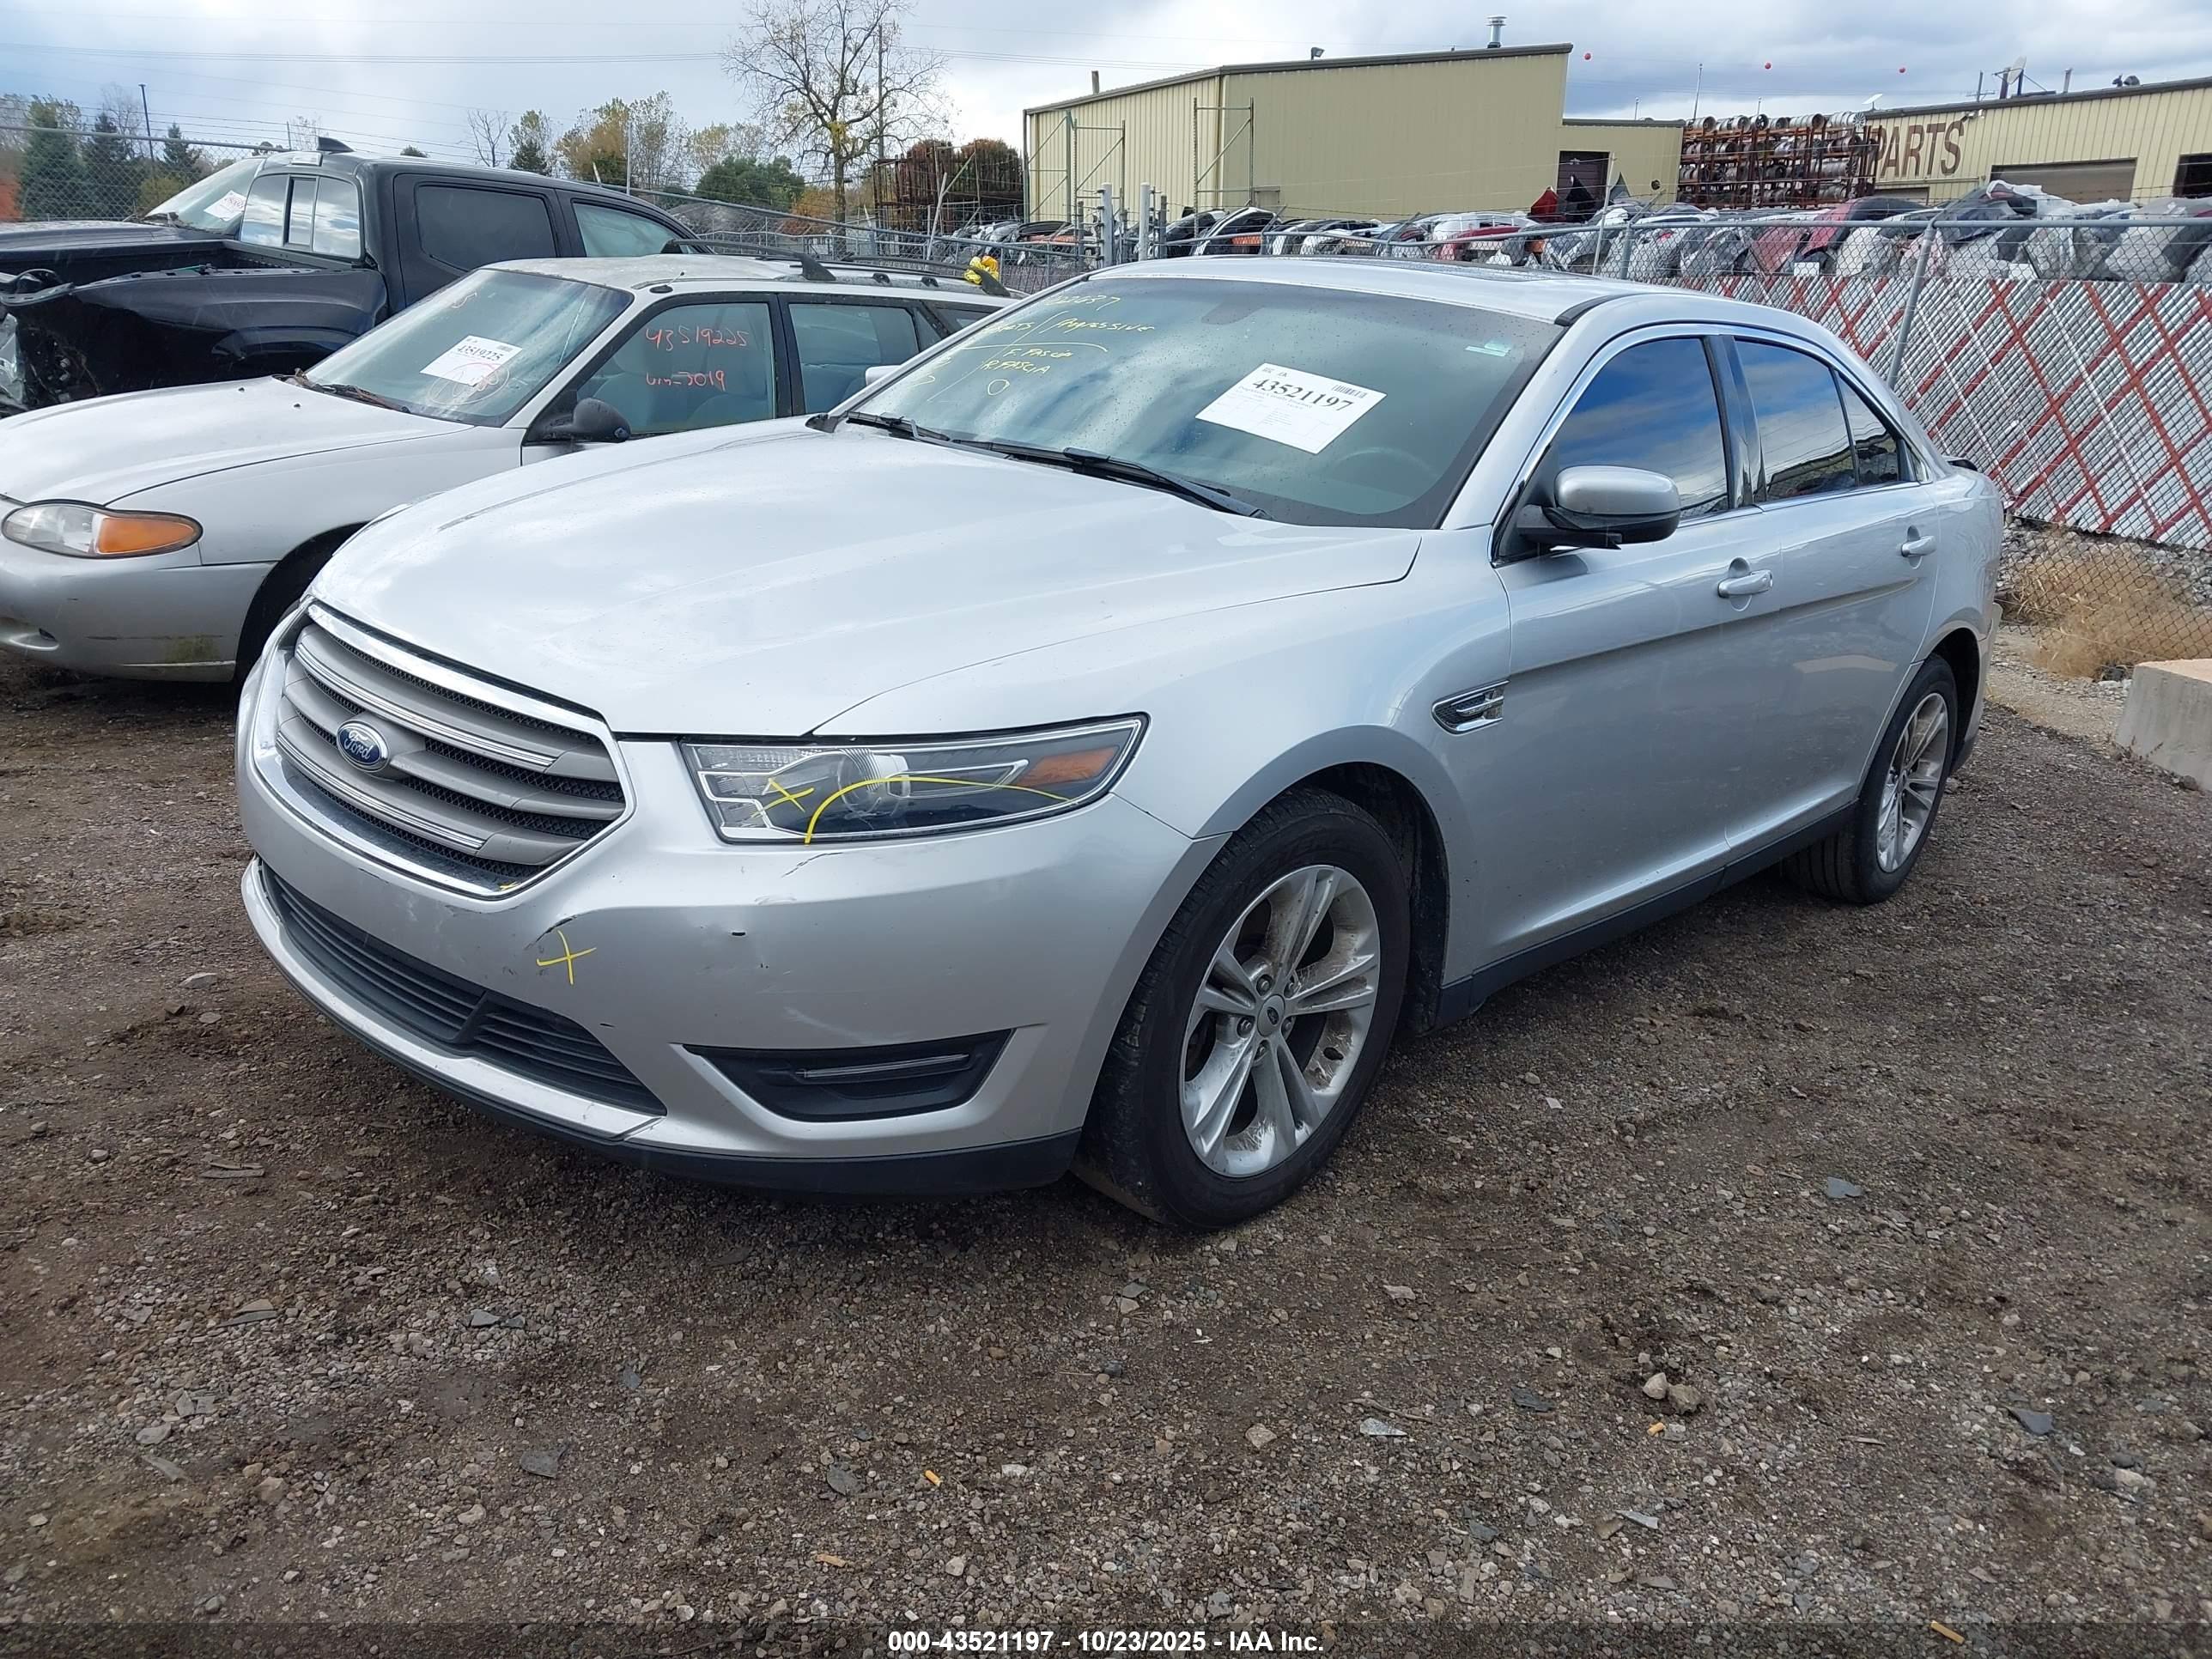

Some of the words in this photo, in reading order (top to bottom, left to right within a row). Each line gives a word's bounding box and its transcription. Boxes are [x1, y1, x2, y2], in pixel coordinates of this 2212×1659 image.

[1868, 120, 1964, 177] PARTS
[646, 325, 749, 351] 43519225
[1252, 378, 1353, 411] 43521197
[343, 730, 374, 760] Ford
